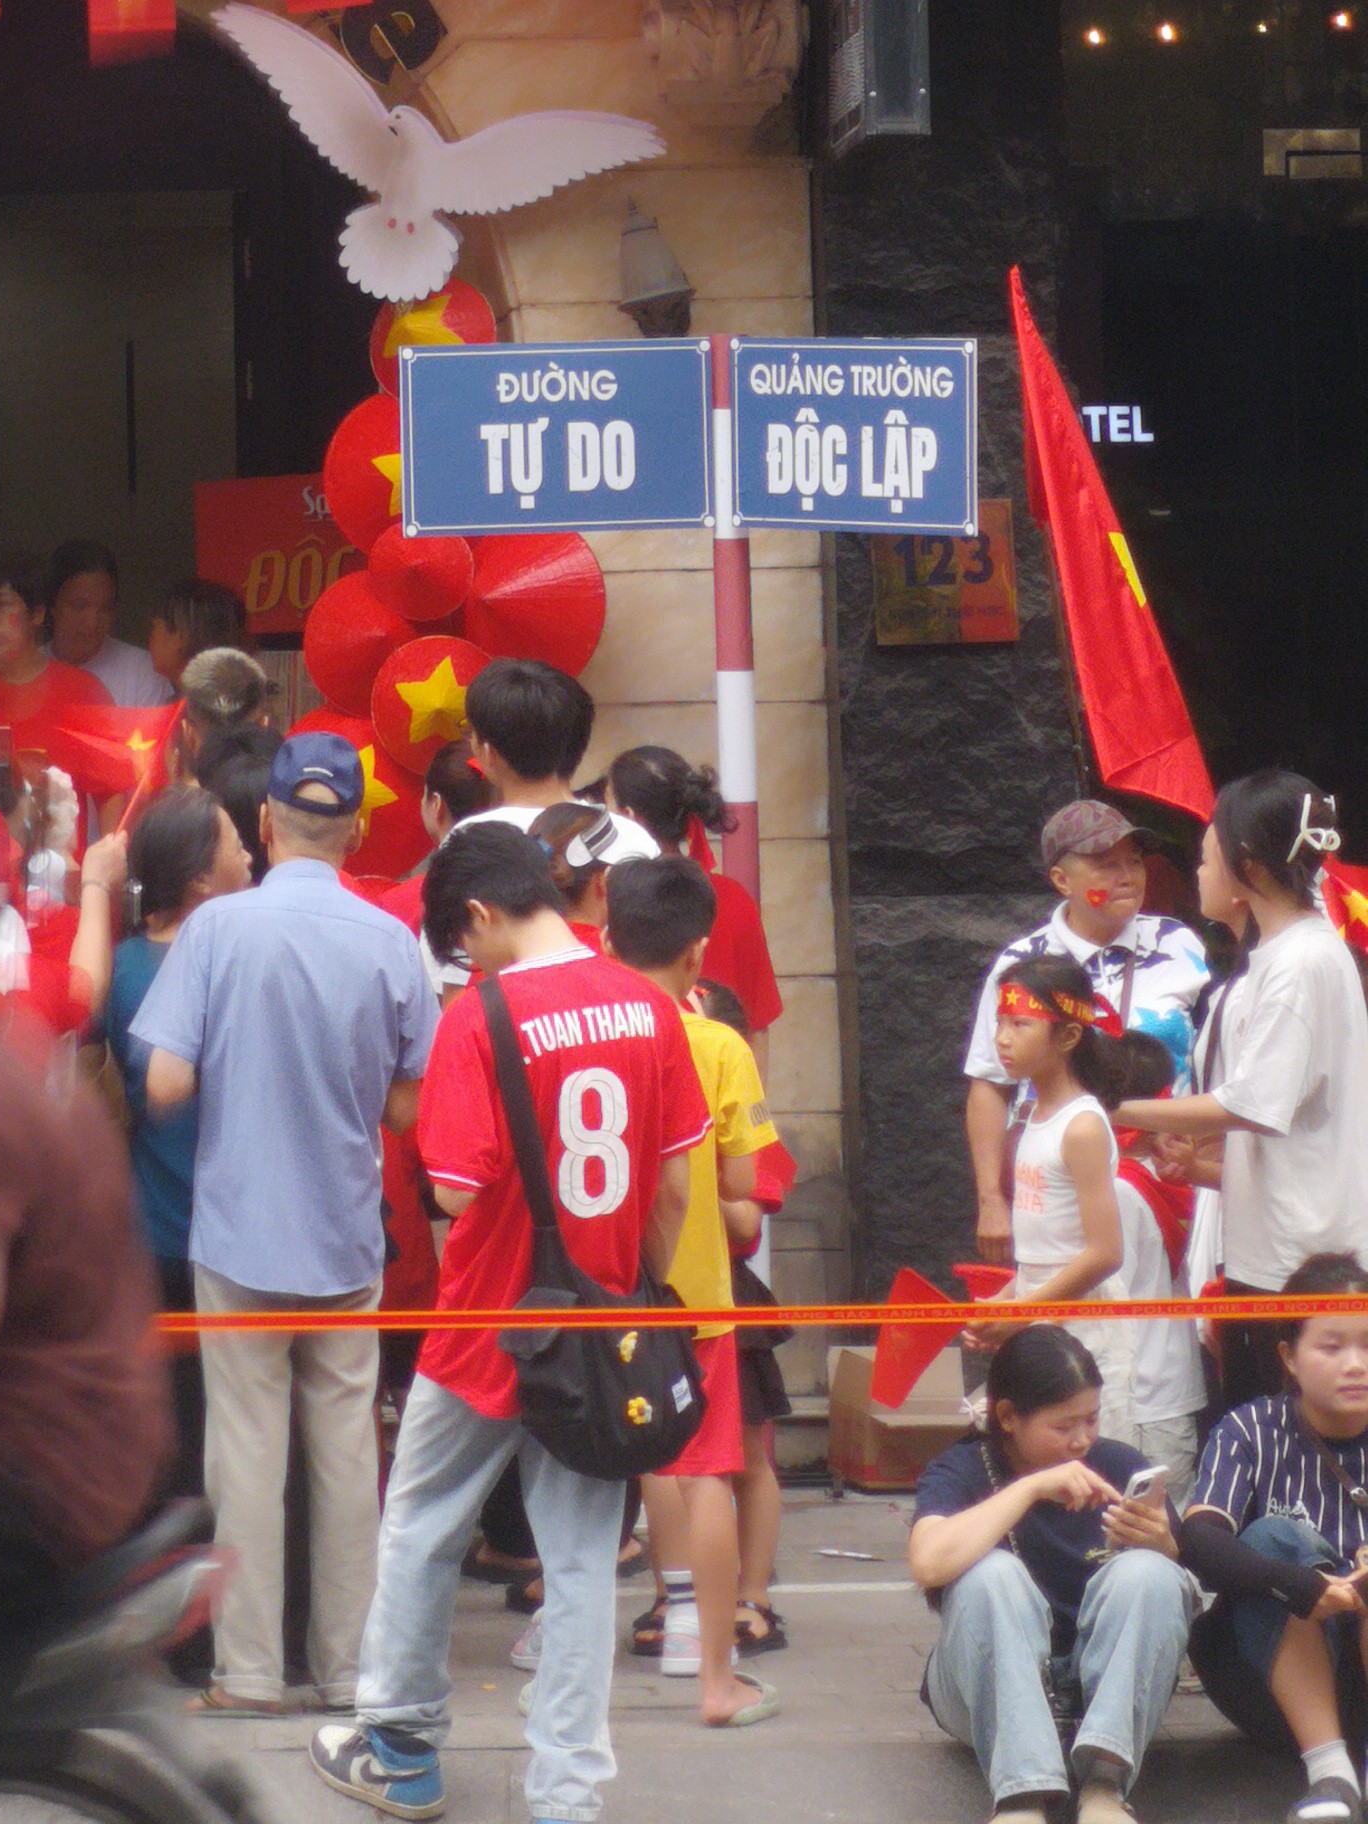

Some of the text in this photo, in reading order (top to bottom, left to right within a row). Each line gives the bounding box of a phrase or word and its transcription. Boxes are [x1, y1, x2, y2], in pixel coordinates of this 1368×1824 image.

[496, 362, 619, 403] ĐƯỜNG
[750, 352, 955, 399] QUẢNG TRƯỜNG
[1079, 405, 1154, 443] TEL
[480, 416, 636, 509] TỰ DO
[766, 407, 937, 514] ĐỘC LẬP
[894, 534, 994, 587] 123
[582, 1002, 655, 1044] THANH
[558, 1067, 630, 1219] 8
